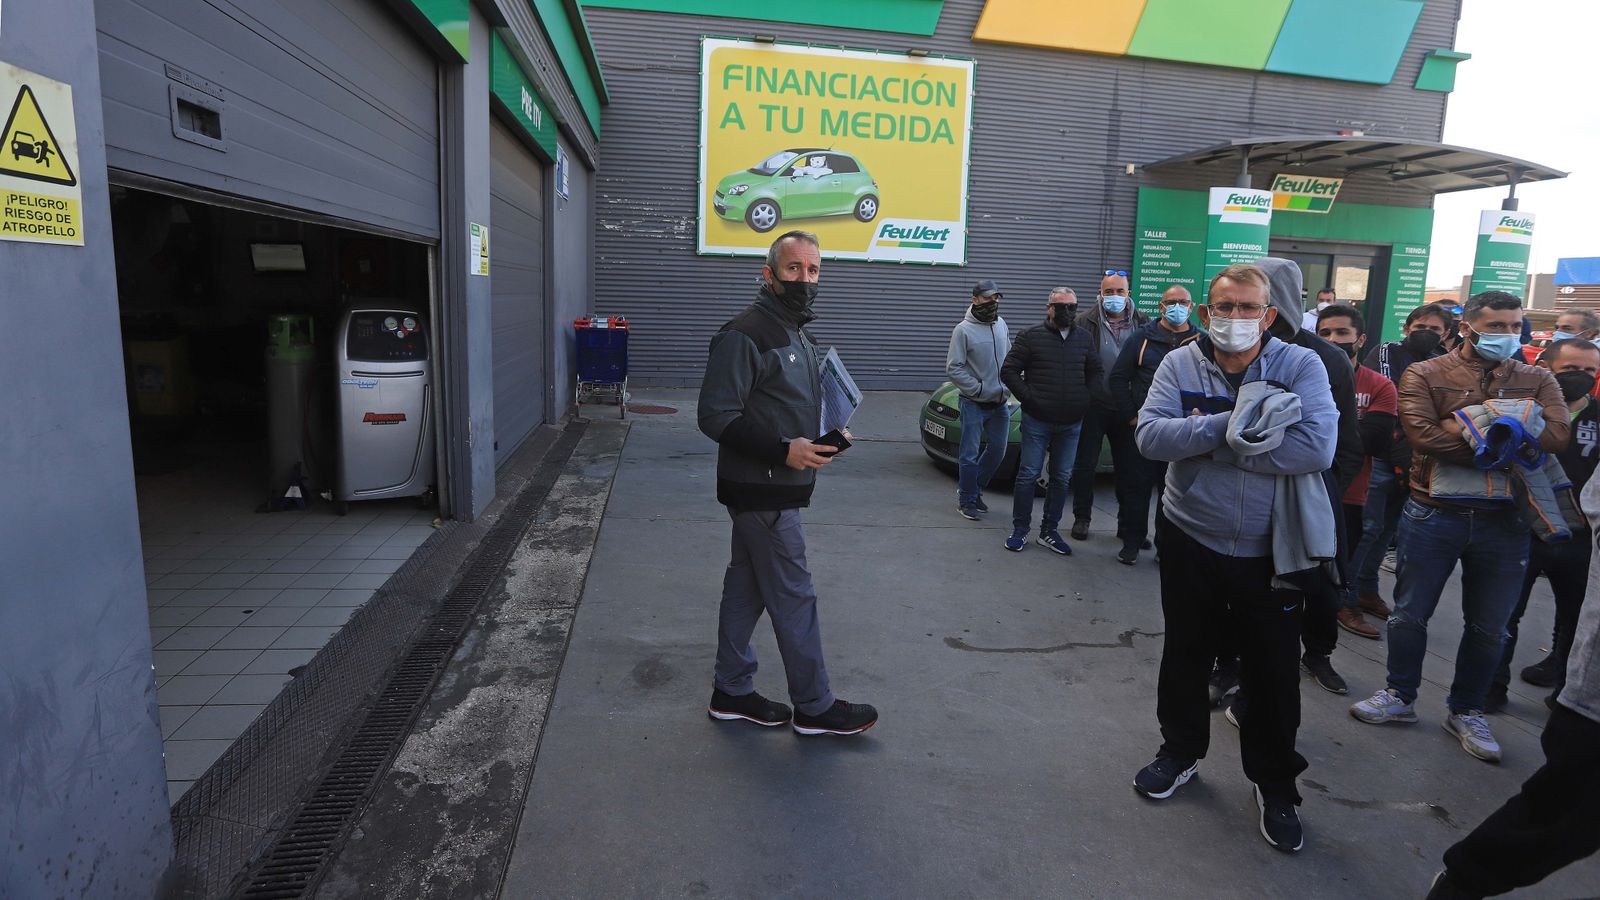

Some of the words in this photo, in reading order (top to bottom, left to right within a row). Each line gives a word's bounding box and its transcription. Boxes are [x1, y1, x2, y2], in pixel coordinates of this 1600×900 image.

[723, 64, 957, 108] FINANCIACIÓN
[521, 85, 532, 121] PRE
[719, 102, 746, 131] A
[758, 104, 804, 134] TU
[820, 108, 955, 145] MEDIDA
[6, 193, 68, 211] ¡PELIGRO!
[4, 207, 53, 222] RIESGO
[56, 213, 72, 224] DE
[2, 221, 76, 237] ATROPELLO
[1144, 230, 1168, 239] TALLER
[1223, 243, 1262, 251] BIENVENIDOS
